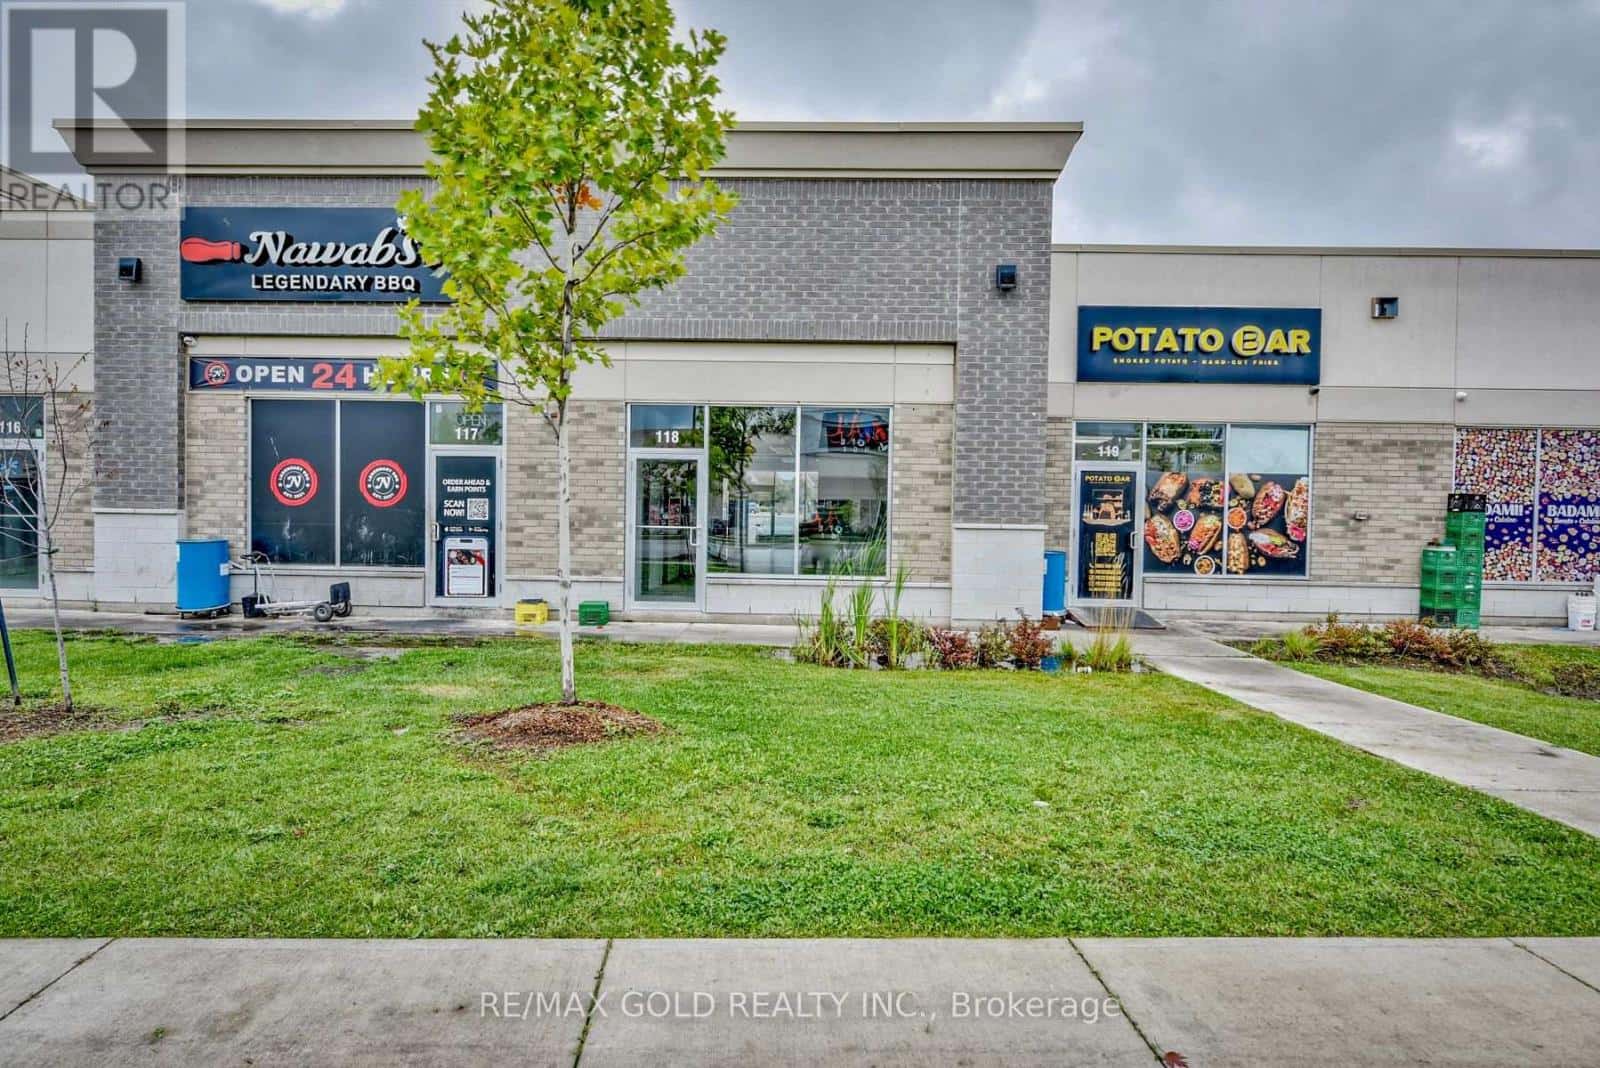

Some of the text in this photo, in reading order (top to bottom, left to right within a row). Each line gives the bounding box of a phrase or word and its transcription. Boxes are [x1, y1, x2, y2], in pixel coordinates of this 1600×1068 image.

[251, 274, 415, 291] LEGENDARY BBQ
[1092, 324, 1311, 357] POTATO BAR
[235, 364, 304, 384] OPEN
[311, 362, 357, 390] 24
[455, 427, 479, 441] 117
[655, 429, 680, 444] 118
[443, 499, 465, 508] SCAN
